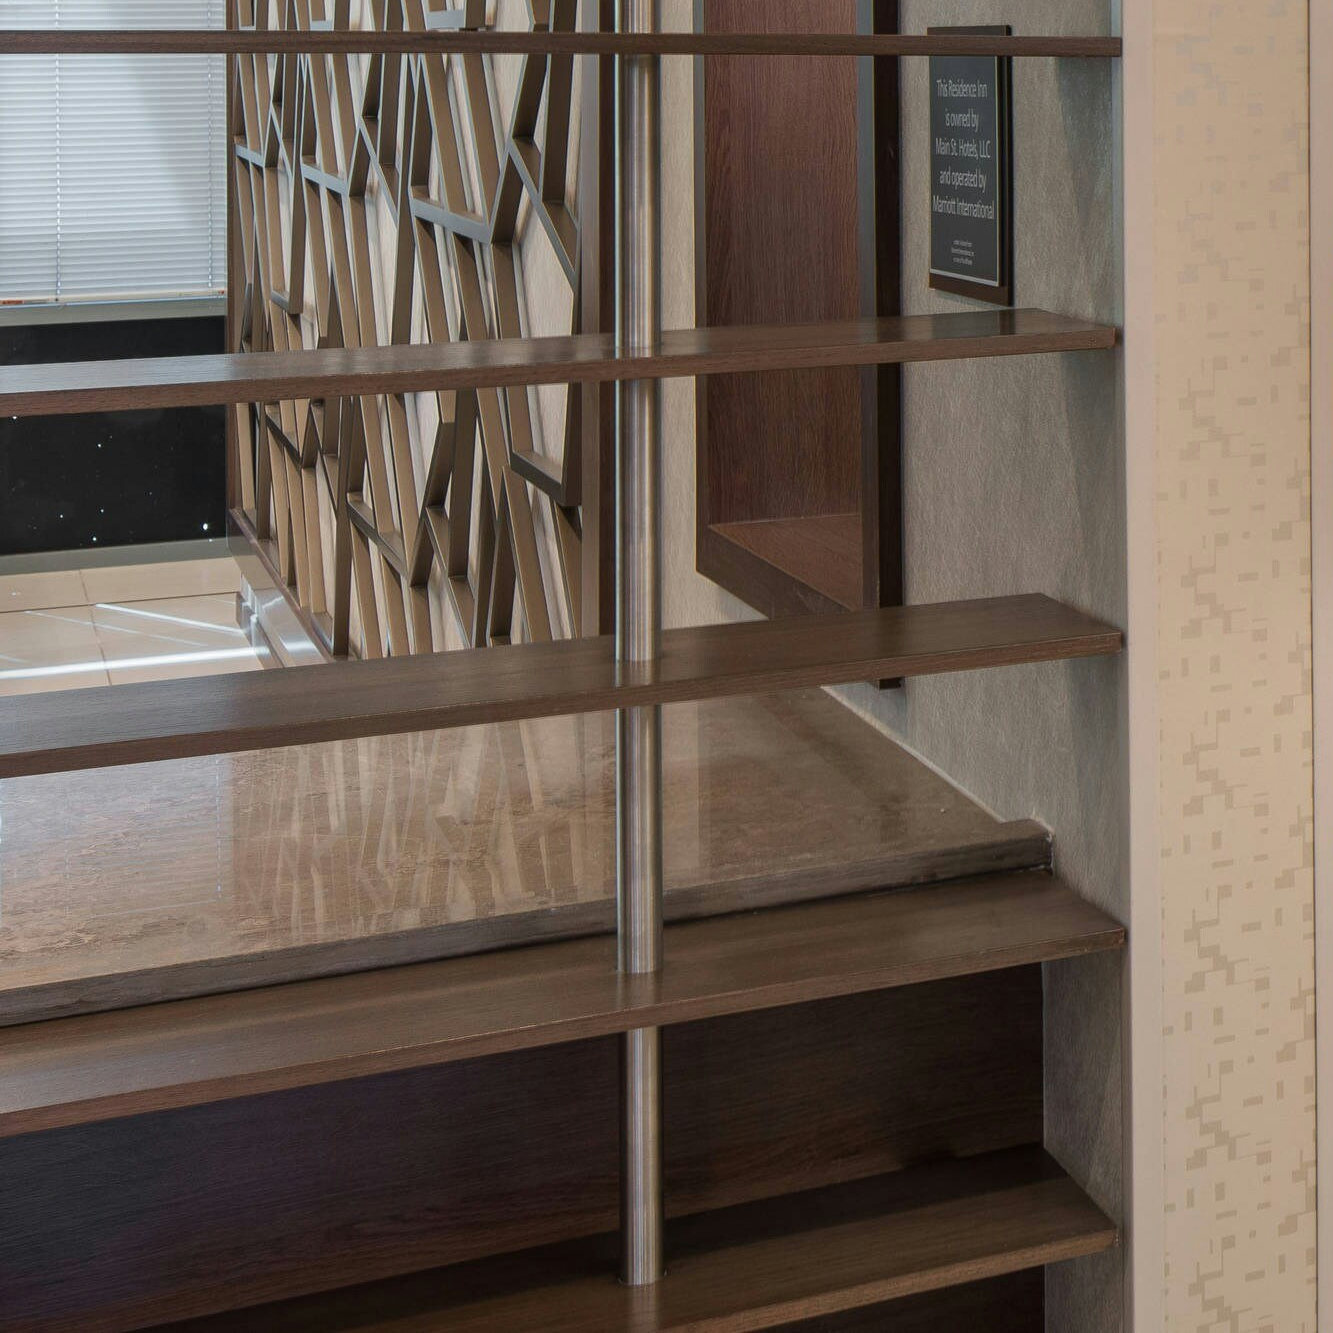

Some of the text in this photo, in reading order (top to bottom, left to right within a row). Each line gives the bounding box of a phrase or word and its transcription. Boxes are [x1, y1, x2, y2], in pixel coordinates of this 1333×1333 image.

[936, 79, 988, 98] This Residence Inn
[945, 108, 980, 132] is owned by
[935, 137, 991, 160] Main Hotels, LLC
[939, 165, 987, 193] and operated by
[932, 195, 994, 219] Marriott International
